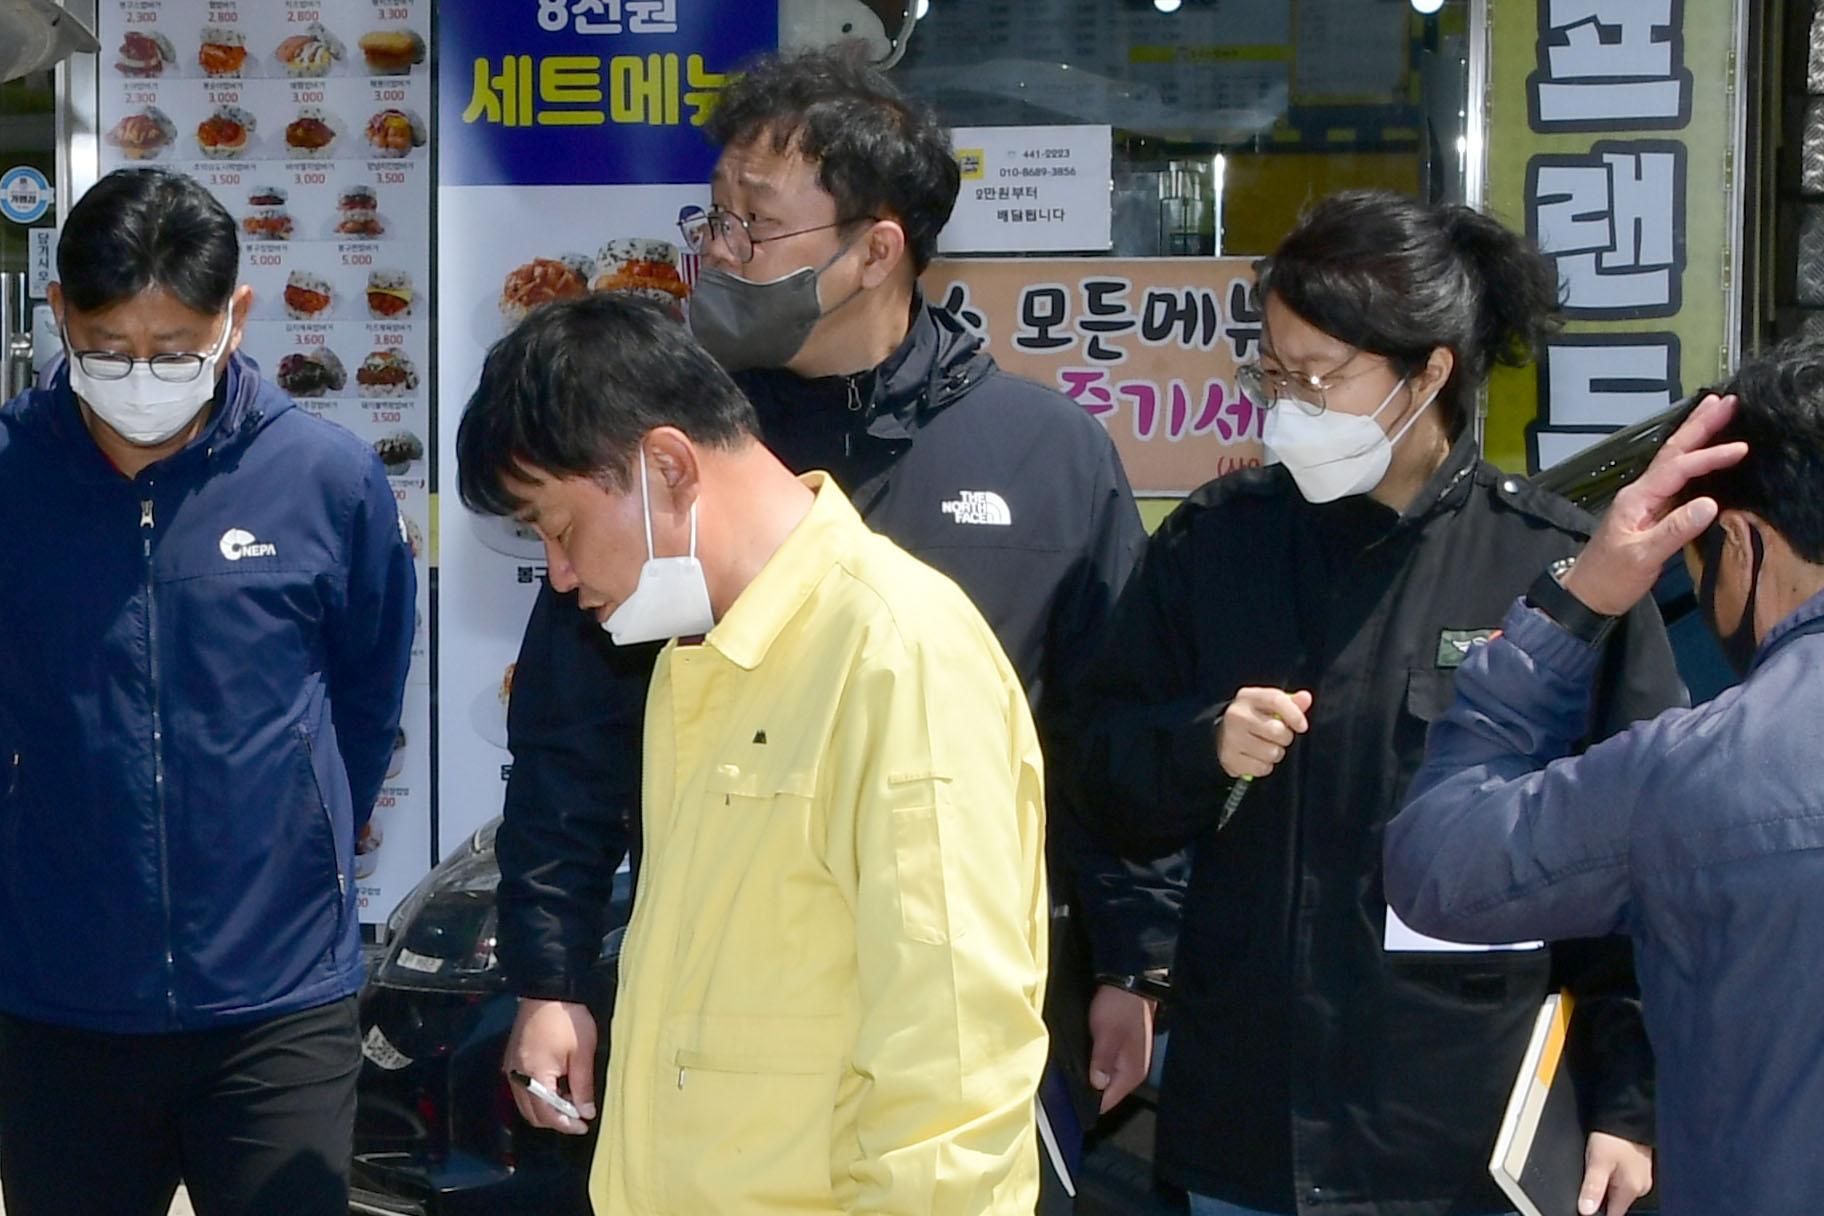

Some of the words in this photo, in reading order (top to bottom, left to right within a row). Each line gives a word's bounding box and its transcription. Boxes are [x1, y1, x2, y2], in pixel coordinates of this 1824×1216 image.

[126, 12, 157, 23] 2,300
[208, 11, 238, 23] 2,800
[287, 10, 319, 22] 2,800
[377, 8, 408, 20] 3,300
[125, 92, 156, 104] 2,300
[208, 92, 238, 104] 3,000
[292, 92, 324, 104] 3,000
[374, 90, 405, 102] 3,000
[209, 173, 241, 185] 3,500
[294, 172, 326, 185] 3,000
[376, 172, 406, 184] 3,500
[997, 208, 1065, 223] 배달됩니다
[36, 232, 50, 282] 당기시오
[250, 254, 282, 266] 5,000
[342, 254, 373, 266] 5,000
[371, 411, 401, 423] 3,500
[959, 490, 986, 503] THE
[941, 500, 987, 514] NORTH
[954, 512, 987, 524] FACE
[242, 543, 277, 557] NEPA
